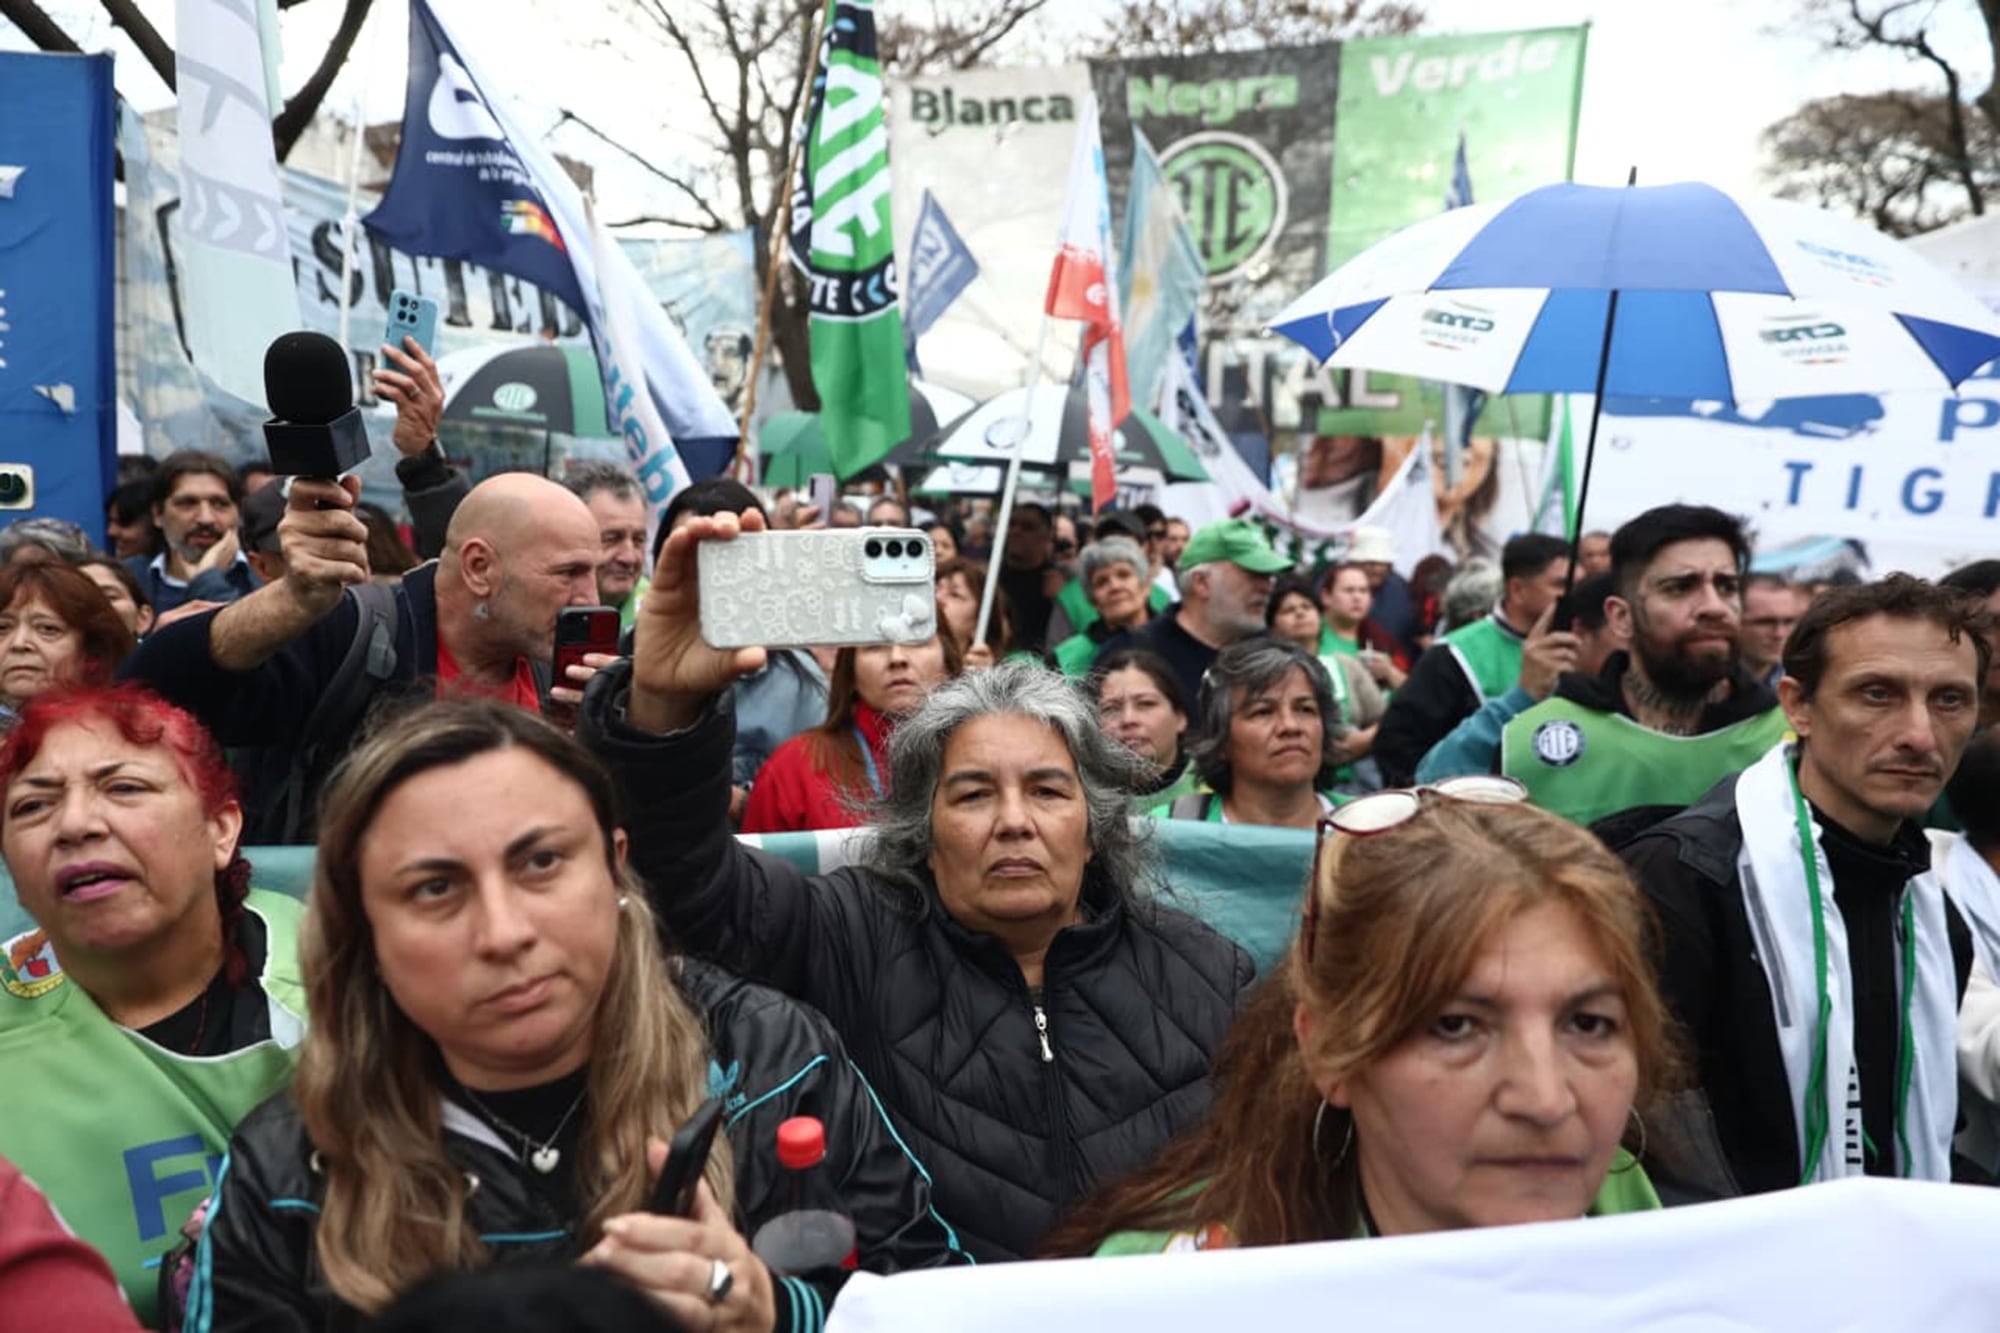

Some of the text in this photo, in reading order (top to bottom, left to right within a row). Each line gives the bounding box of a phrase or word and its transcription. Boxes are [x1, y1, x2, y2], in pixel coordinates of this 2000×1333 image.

[1369, 36, 1560, 98] Verde
[909, 86, 1075, 126] Blanca
[1127, 74, 1298, 124] Negra
[124, 1134, 225, 1242] F
